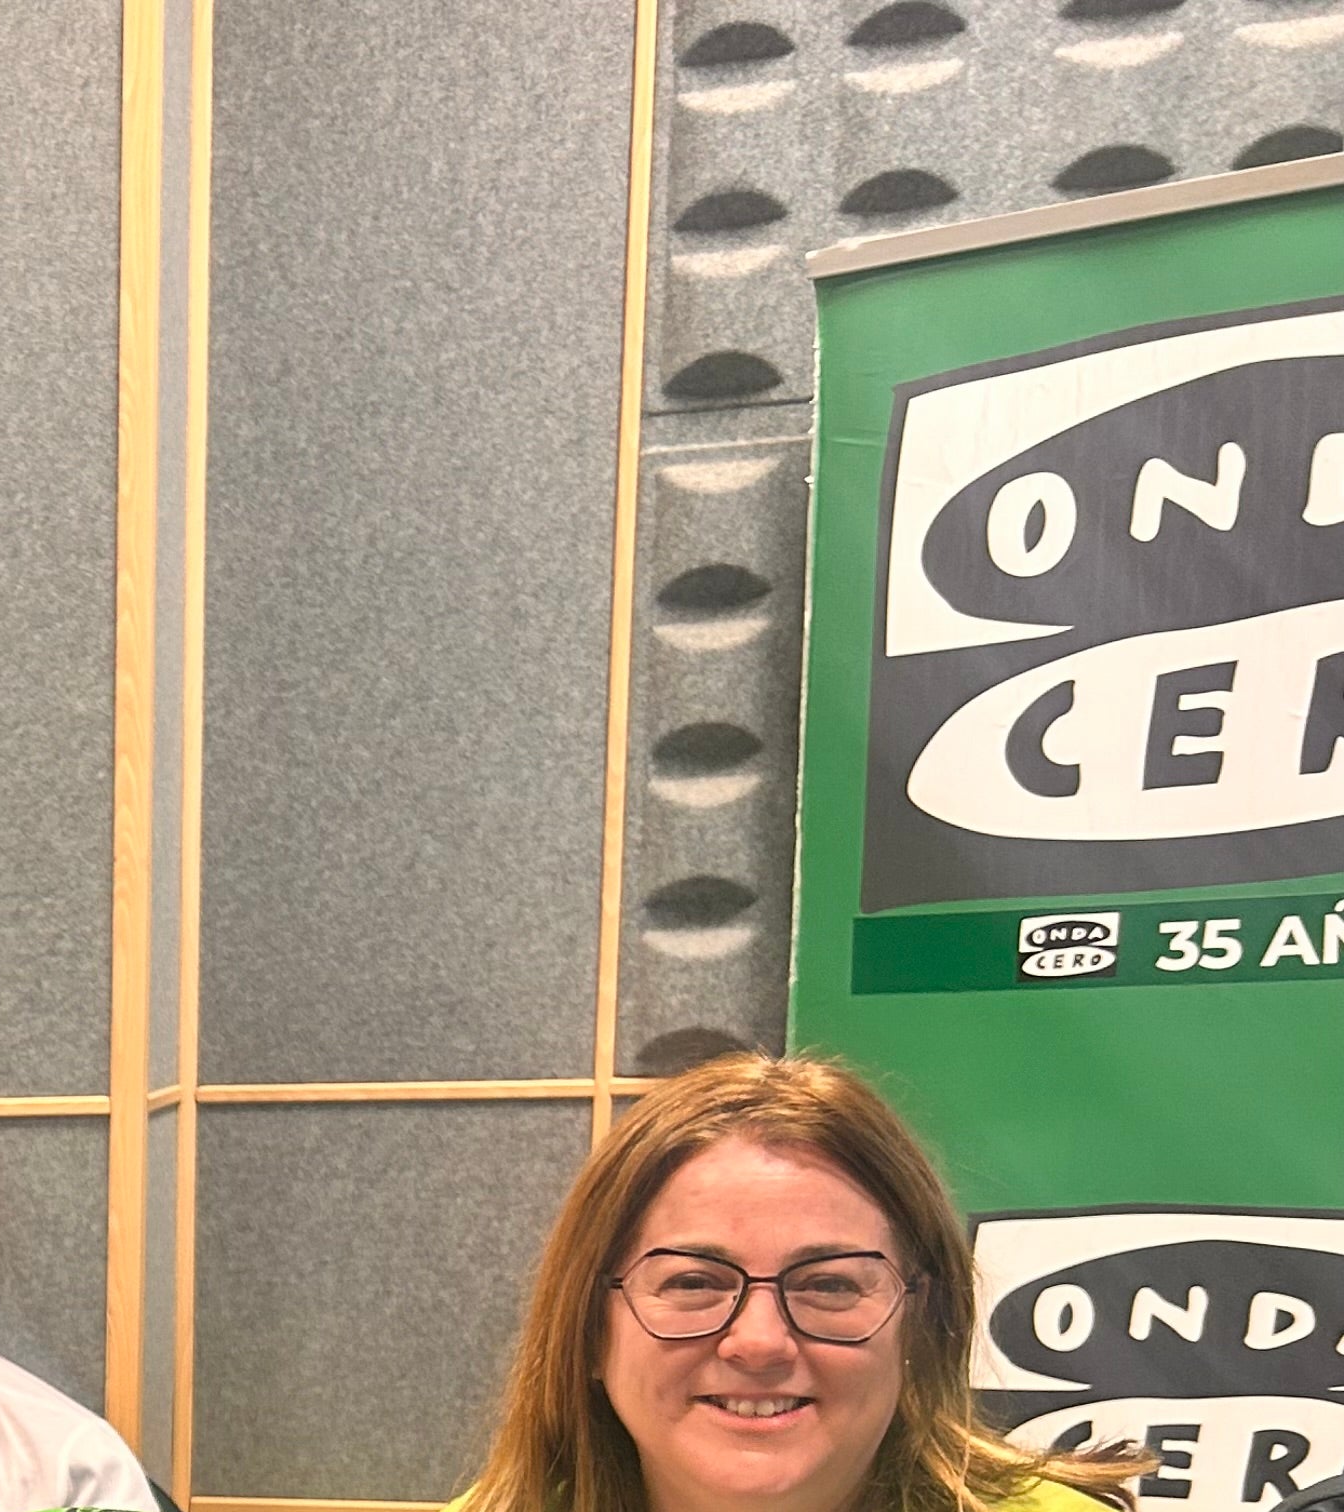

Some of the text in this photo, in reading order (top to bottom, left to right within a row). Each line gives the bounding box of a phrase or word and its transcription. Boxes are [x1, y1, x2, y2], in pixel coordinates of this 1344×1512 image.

[1031, 926, 1106, 945] ONDA
[1036, 953, 1103, 970] CERO
[1155, 918, 1243, 971] 35
[1032, 1283, 1344, 1356] OND
[1049, 1420, 1312, 1503] ER
